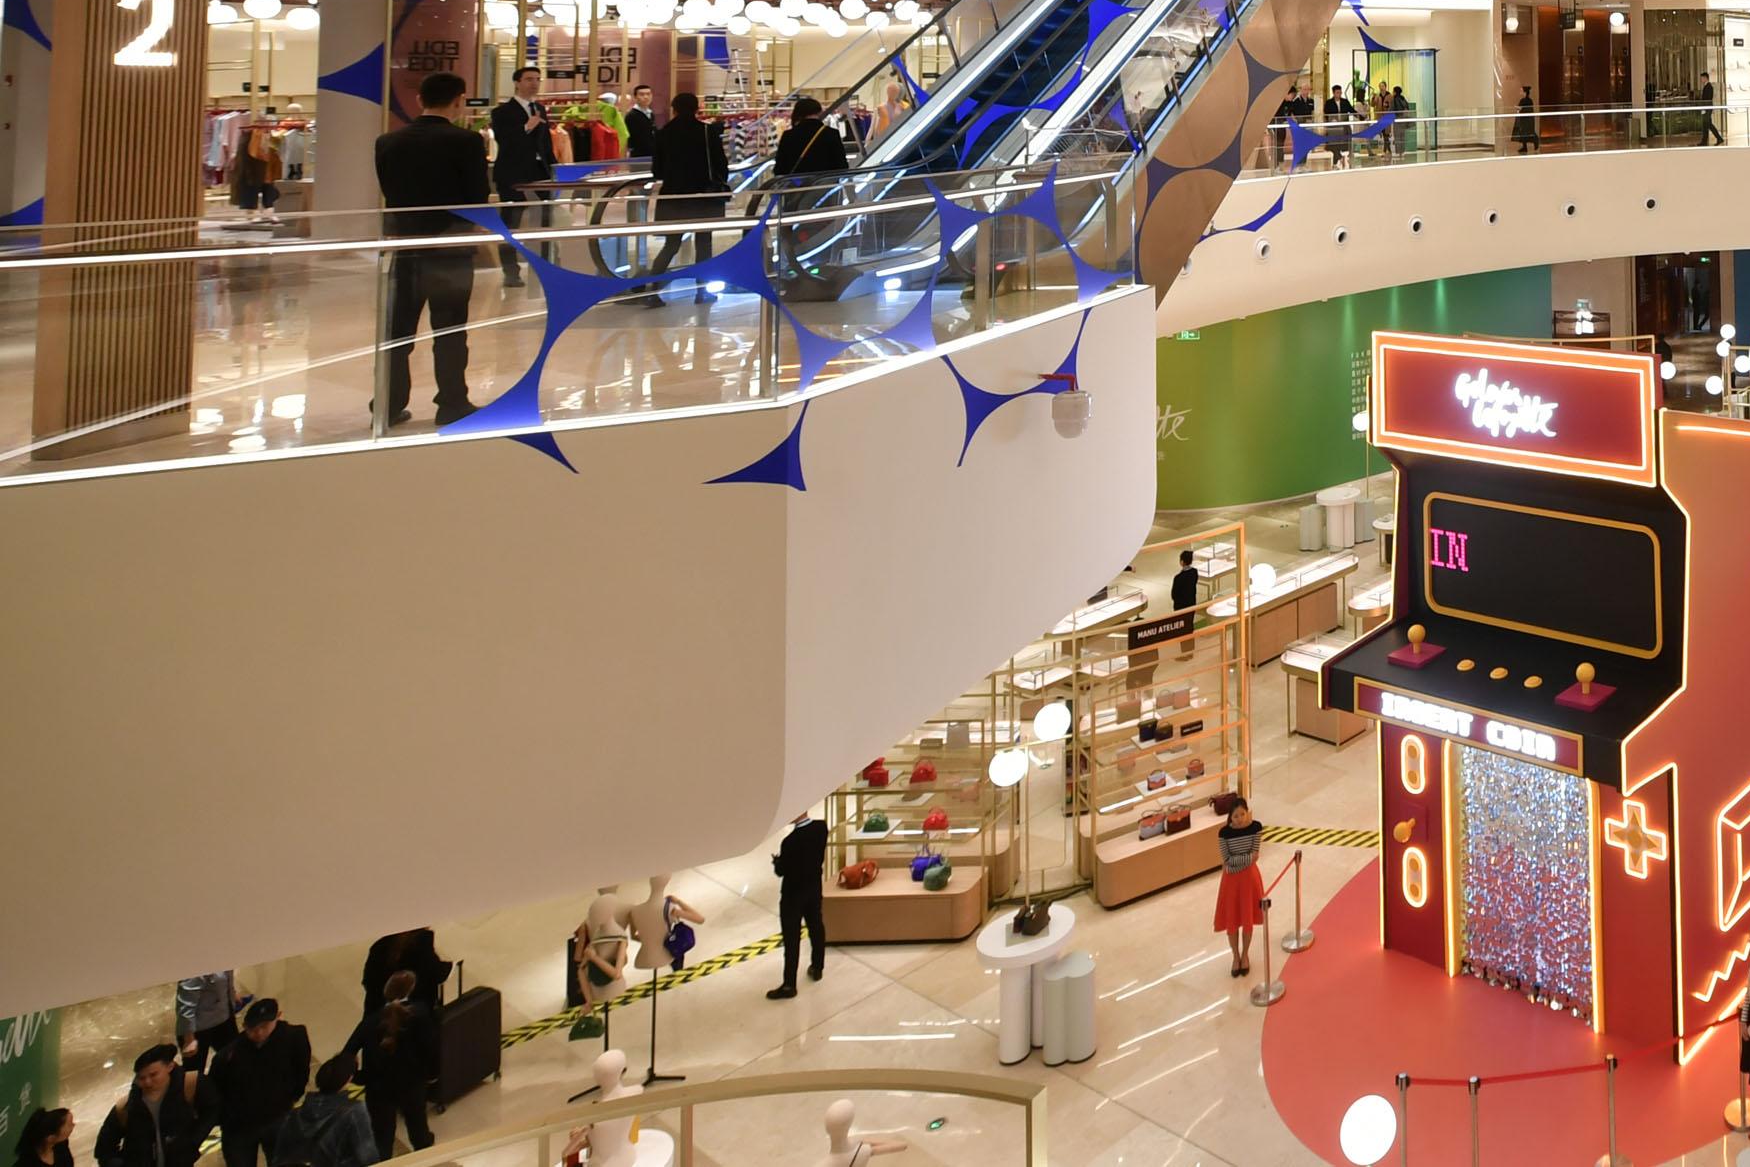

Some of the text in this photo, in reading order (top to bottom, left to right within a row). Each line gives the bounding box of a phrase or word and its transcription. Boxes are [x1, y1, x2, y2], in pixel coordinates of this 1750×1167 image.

[408, 56, 459, 71] EDIT
[1430, 528, 1469, 572] IN
[1137, 620, 1185, 640] MANU ATELIER
[1381, 691, 1557, 762] INSERT COIN
